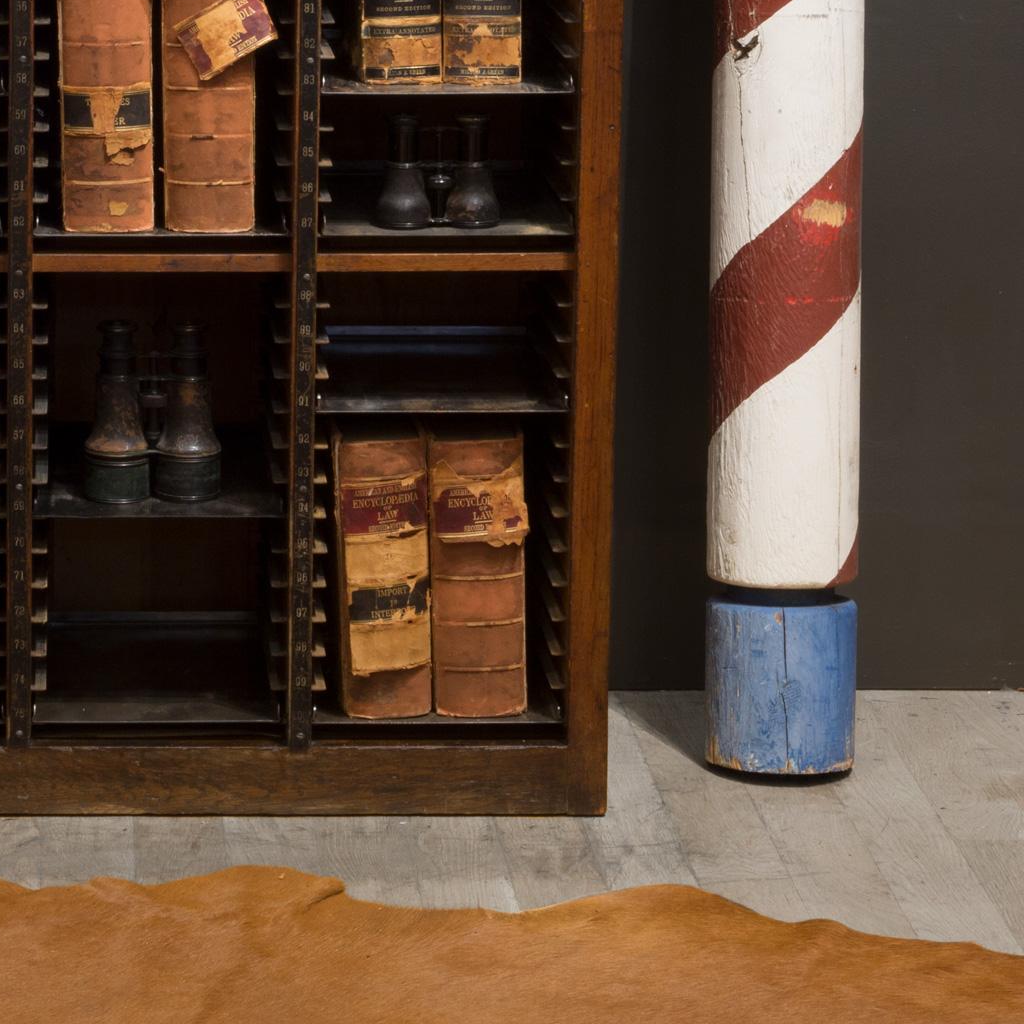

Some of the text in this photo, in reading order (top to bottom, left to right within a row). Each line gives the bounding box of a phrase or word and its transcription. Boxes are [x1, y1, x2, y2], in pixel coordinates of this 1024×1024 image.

[303, 2, 315, 14] 81
[304, 38, 315, 49] 82
[16, 72, 27, 84] 58
[303, 74, 315, 85] 83
[303, 111, 314, 122] 84
[14, 144, 26, 155] 60
[302, 146, 314, 157] 85
[13, 180, 25, 191] 61
[302, 182, 313, 193] 86
[13, 288, 24, 299] 63
[300, 290, 312, 301] 88
[13, 323, 24, 334] 64
[299, 325, 311, 336] 89
[299, 361, 310, 372] 90
[13, 394, 24, 405] 66
[298, 395, 310, 406] 91
[298, 433, 310, 444] 92
[298, 467, 309, 478] 93
[377, 509, 399, 520] LAW
[473, 510, 494, 521] LAW
[13, 570, 25, 581] 71
[378, 586, 408, 597] IMPORT
[296, 607, 307, 618] 97
